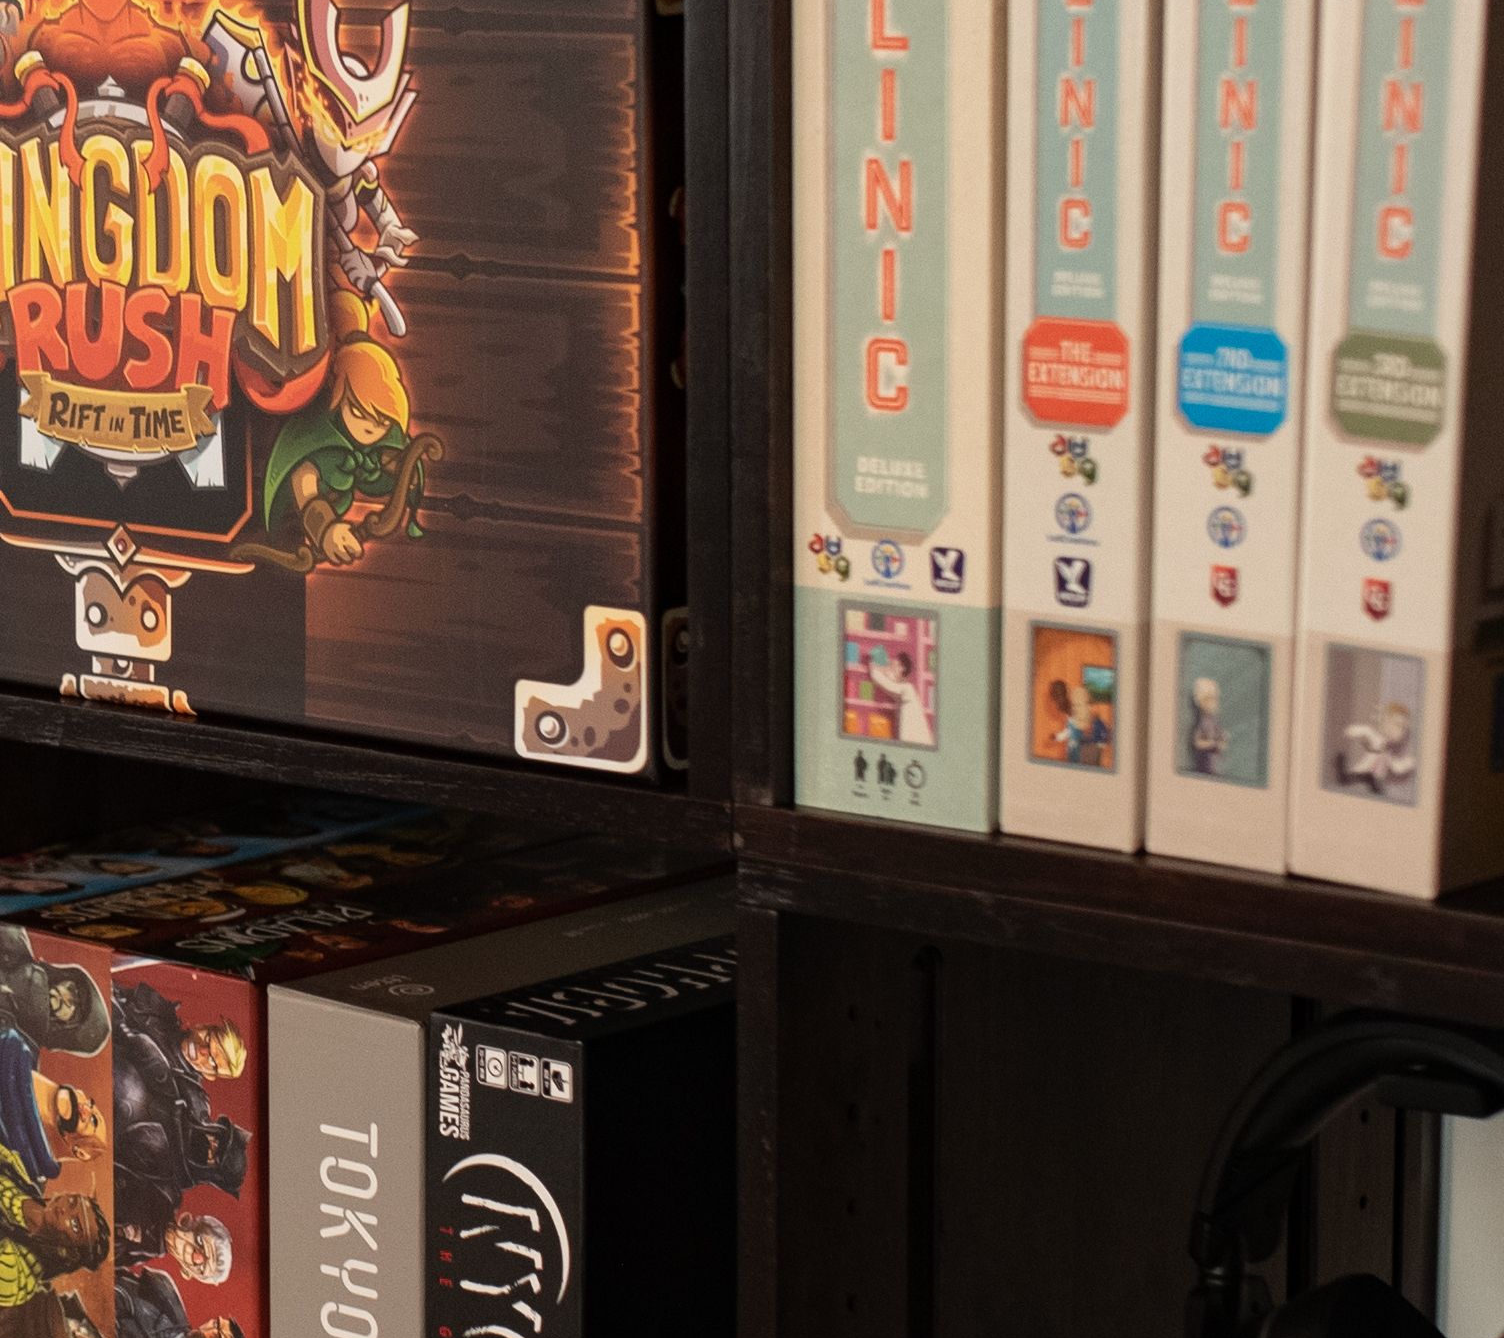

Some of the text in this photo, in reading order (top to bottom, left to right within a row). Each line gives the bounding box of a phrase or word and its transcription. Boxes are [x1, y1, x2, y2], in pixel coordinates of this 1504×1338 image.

[6, 279, 237, 415] RUSH
[1060, 340, 1092, 362] THE
[1027, 361, 1122, 389] EXTENSION
[1181, 368, 1281, 398] EXTENSION
[1335, 375, 1441, 408] EXTENSION
[48, 390, 187, 439] RIFT IN TIME
[855, 456, 927, 479] DELUXE
[853, 476, 930, 499] EDITION
[439, 1066, 460, 1139] GAMES
[459, 1069, 471, 1141] PANDASAURUS
[439, 1226, 454, 1287] THE
